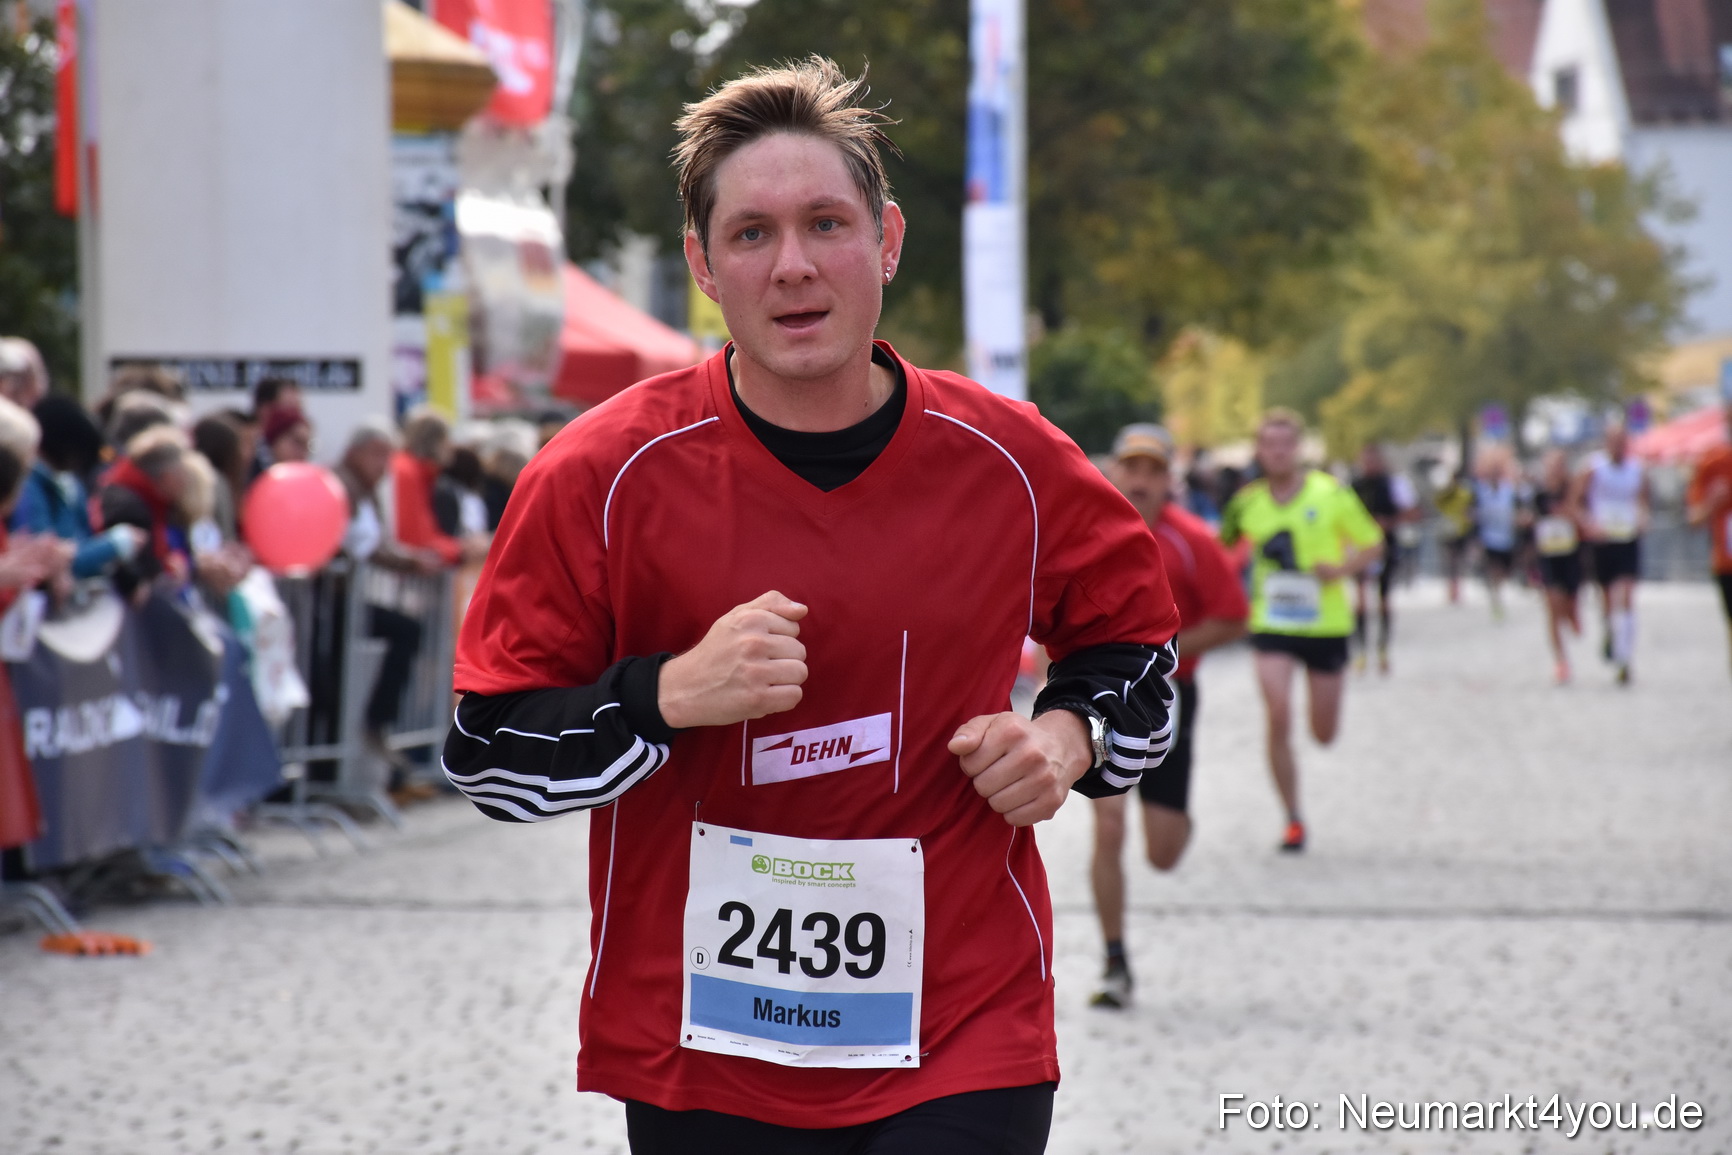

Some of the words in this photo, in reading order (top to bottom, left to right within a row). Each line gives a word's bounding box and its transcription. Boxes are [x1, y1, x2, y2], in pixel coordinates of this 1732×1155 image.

[790, 735, 853, 765] DEHN
[771, 877, 797, 885] inspired
[772, 858, 855, 881] BOCK
[717, 901, 886, 979] 2439
[696, 952, 704, 965] D
[753, 997, 841, 1028] Markus
